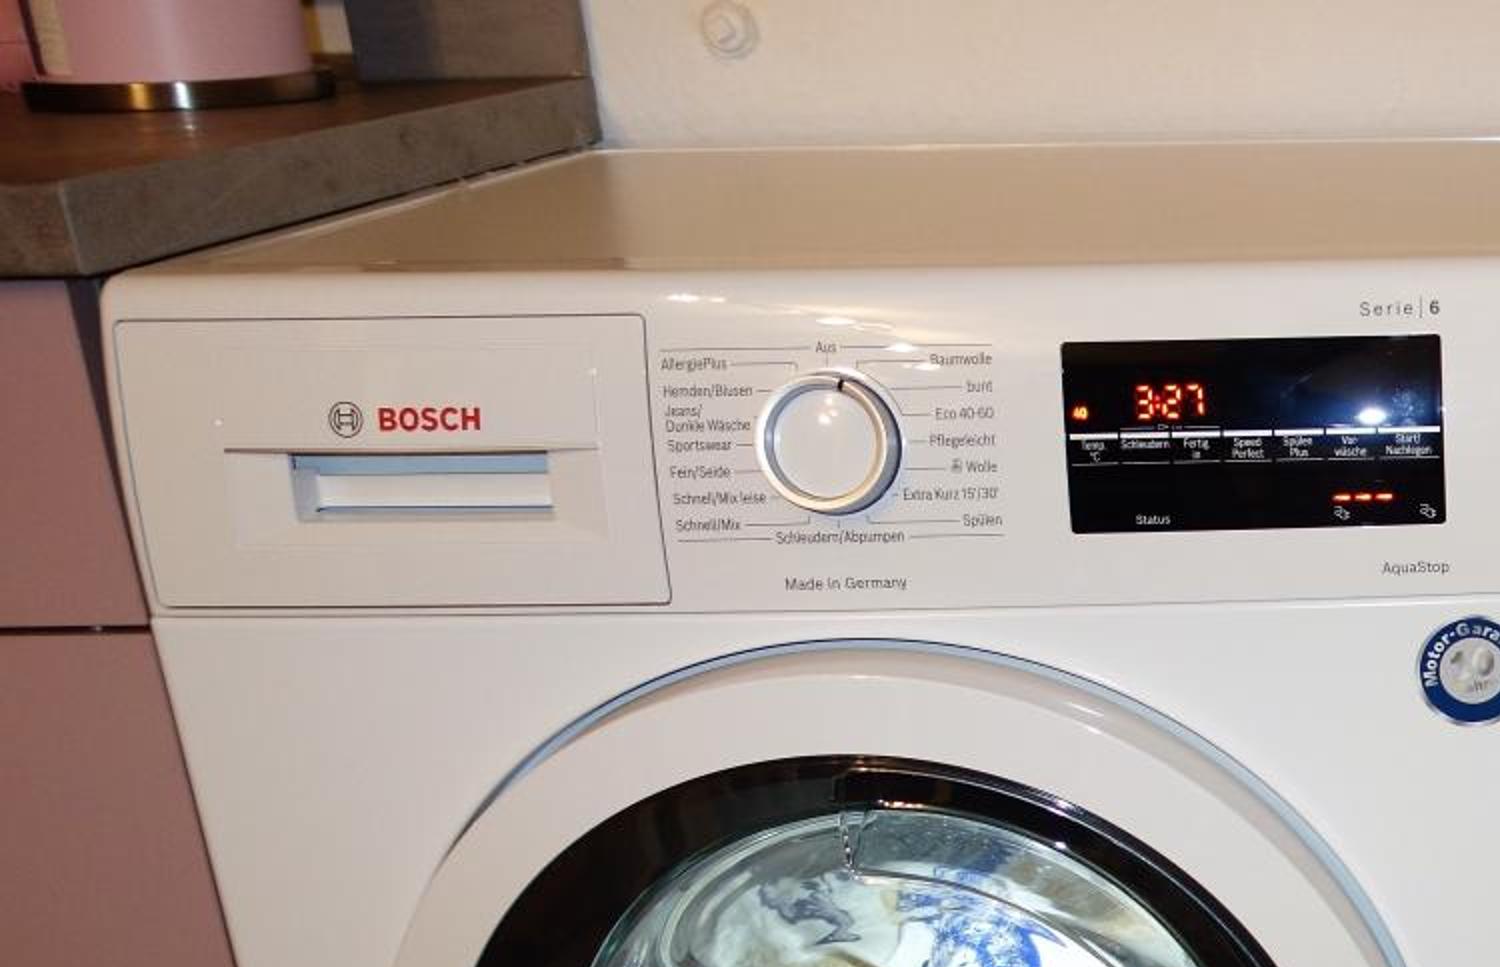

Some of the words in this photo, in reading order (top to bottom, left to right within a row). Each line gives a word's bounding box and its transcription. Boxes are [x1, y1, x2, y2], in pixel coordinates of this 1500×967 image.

[1359, 300, 1414, 317] Serie
[1429, 300, 1441, 315] 6
[815, 341, 837, 353] Aus
[660, 357, 728, 372] AllergiePlus
[929, 352, 993, 366] Baumwolle
[663, 384, 753, 399] Hemden/Blusen
[1135, 383, 1206, 420] 3:27
[377, 407, 482, 432] BOSCH
[935, 407, 957, 420] Eco
[665, 419, 705, 433] Dunkle
[707, 418, 751, 433] Wäsche
[667, 439, 732, 453] Sportswear
[929, 434, 996, 449] Pflegeleicht
[670, 466, 731, 479] Fein/Seide
[966, 459, 998, 473] Wolle
[903, 487, 932, 501] Extra
[675, 519, 741, 533] Schnell/Mix
[962, 513, 1003, 528] Spülen
[1135, 514, 1172, 525] Status
[775, 531, 905, 545] Schleudern/Abpumpen
[1382, 559, 1450, 577] AquaStop
[785, 578, 822, 591] Made
[845, 577, 908, 592] Germany
